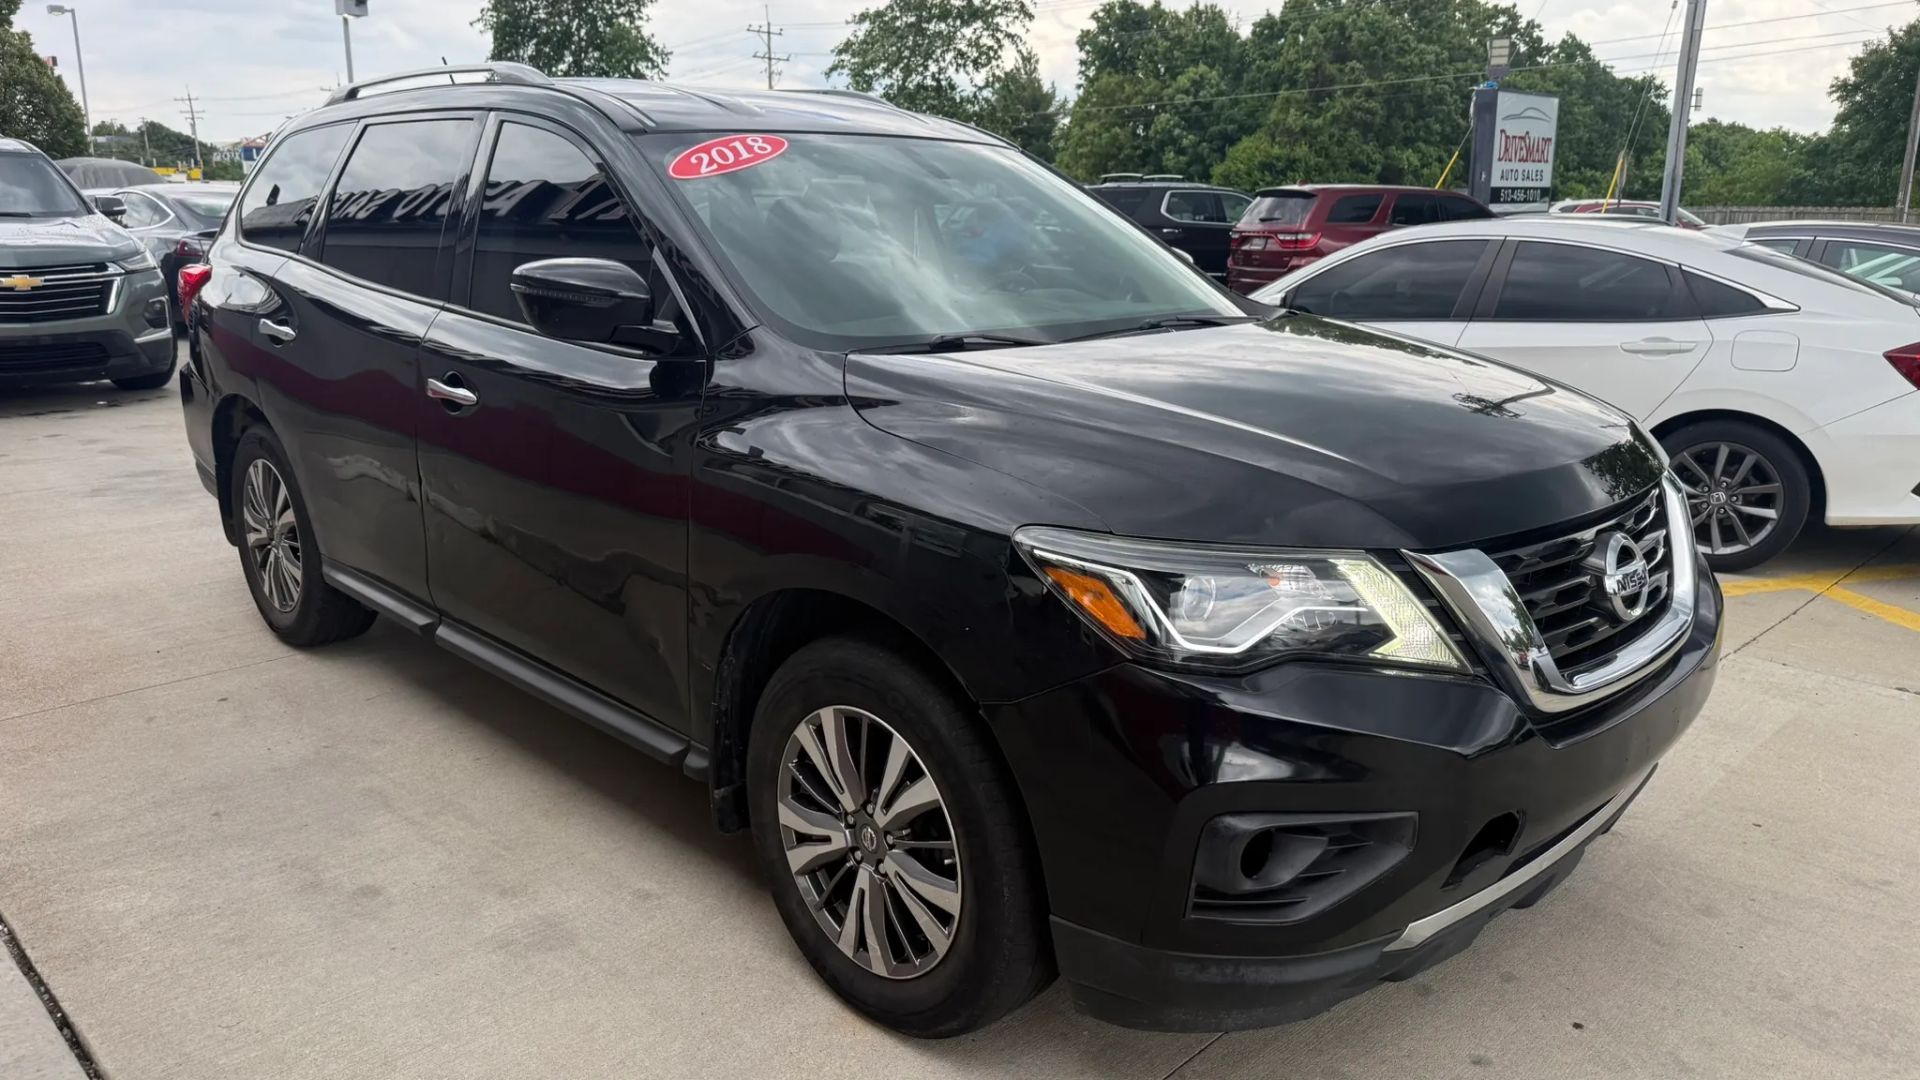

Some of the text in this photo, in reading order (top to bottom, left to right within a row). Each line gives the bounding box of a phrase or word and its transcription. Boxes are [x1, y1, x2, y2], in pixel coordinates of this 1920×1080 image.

[690, 136, 772, 174] 2018
[1500, 169, 1544, 181] AUTO SALES
